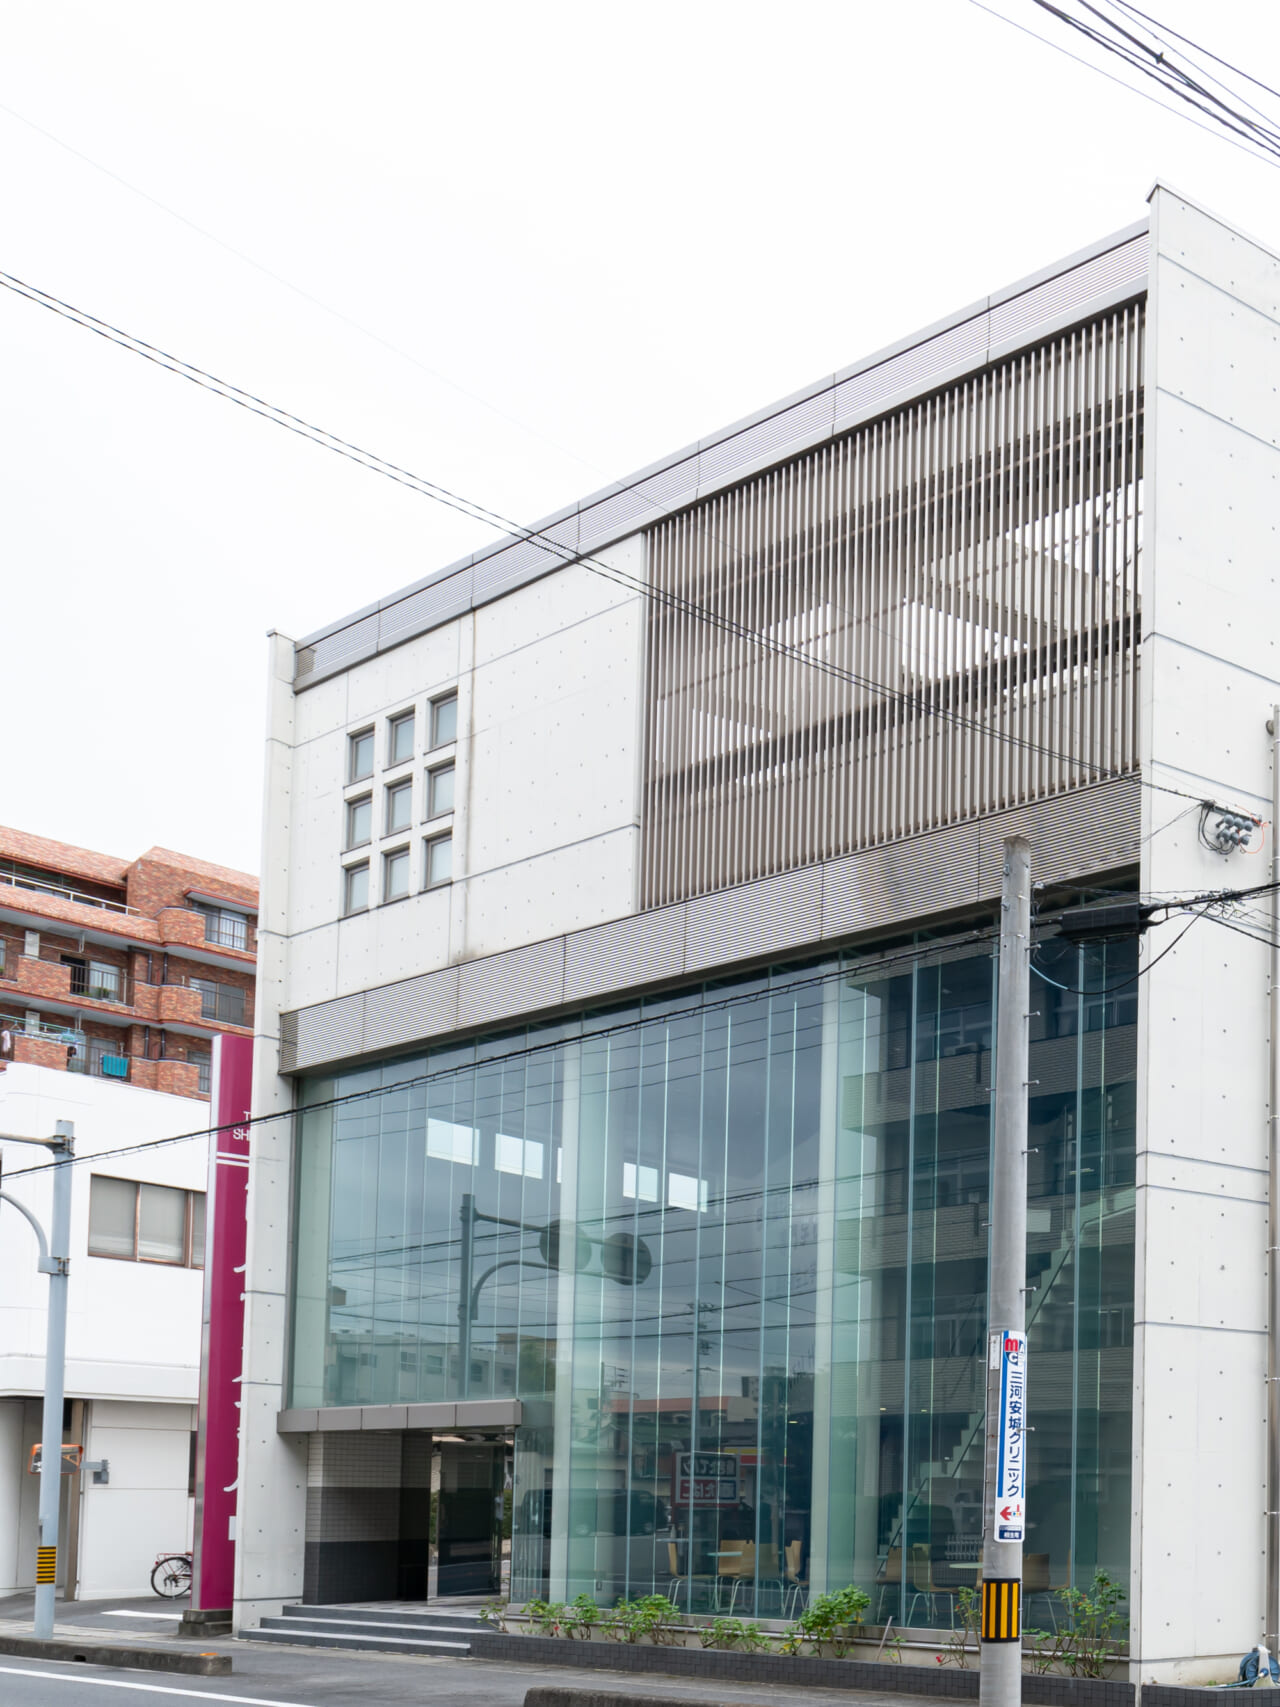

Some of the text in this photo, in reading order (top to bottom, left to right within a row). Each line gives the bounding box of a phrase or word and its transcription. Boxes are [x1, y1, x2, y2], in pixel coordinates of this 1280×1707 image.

[1008, 1370, 1023, 1498] 三河安城クリニック
